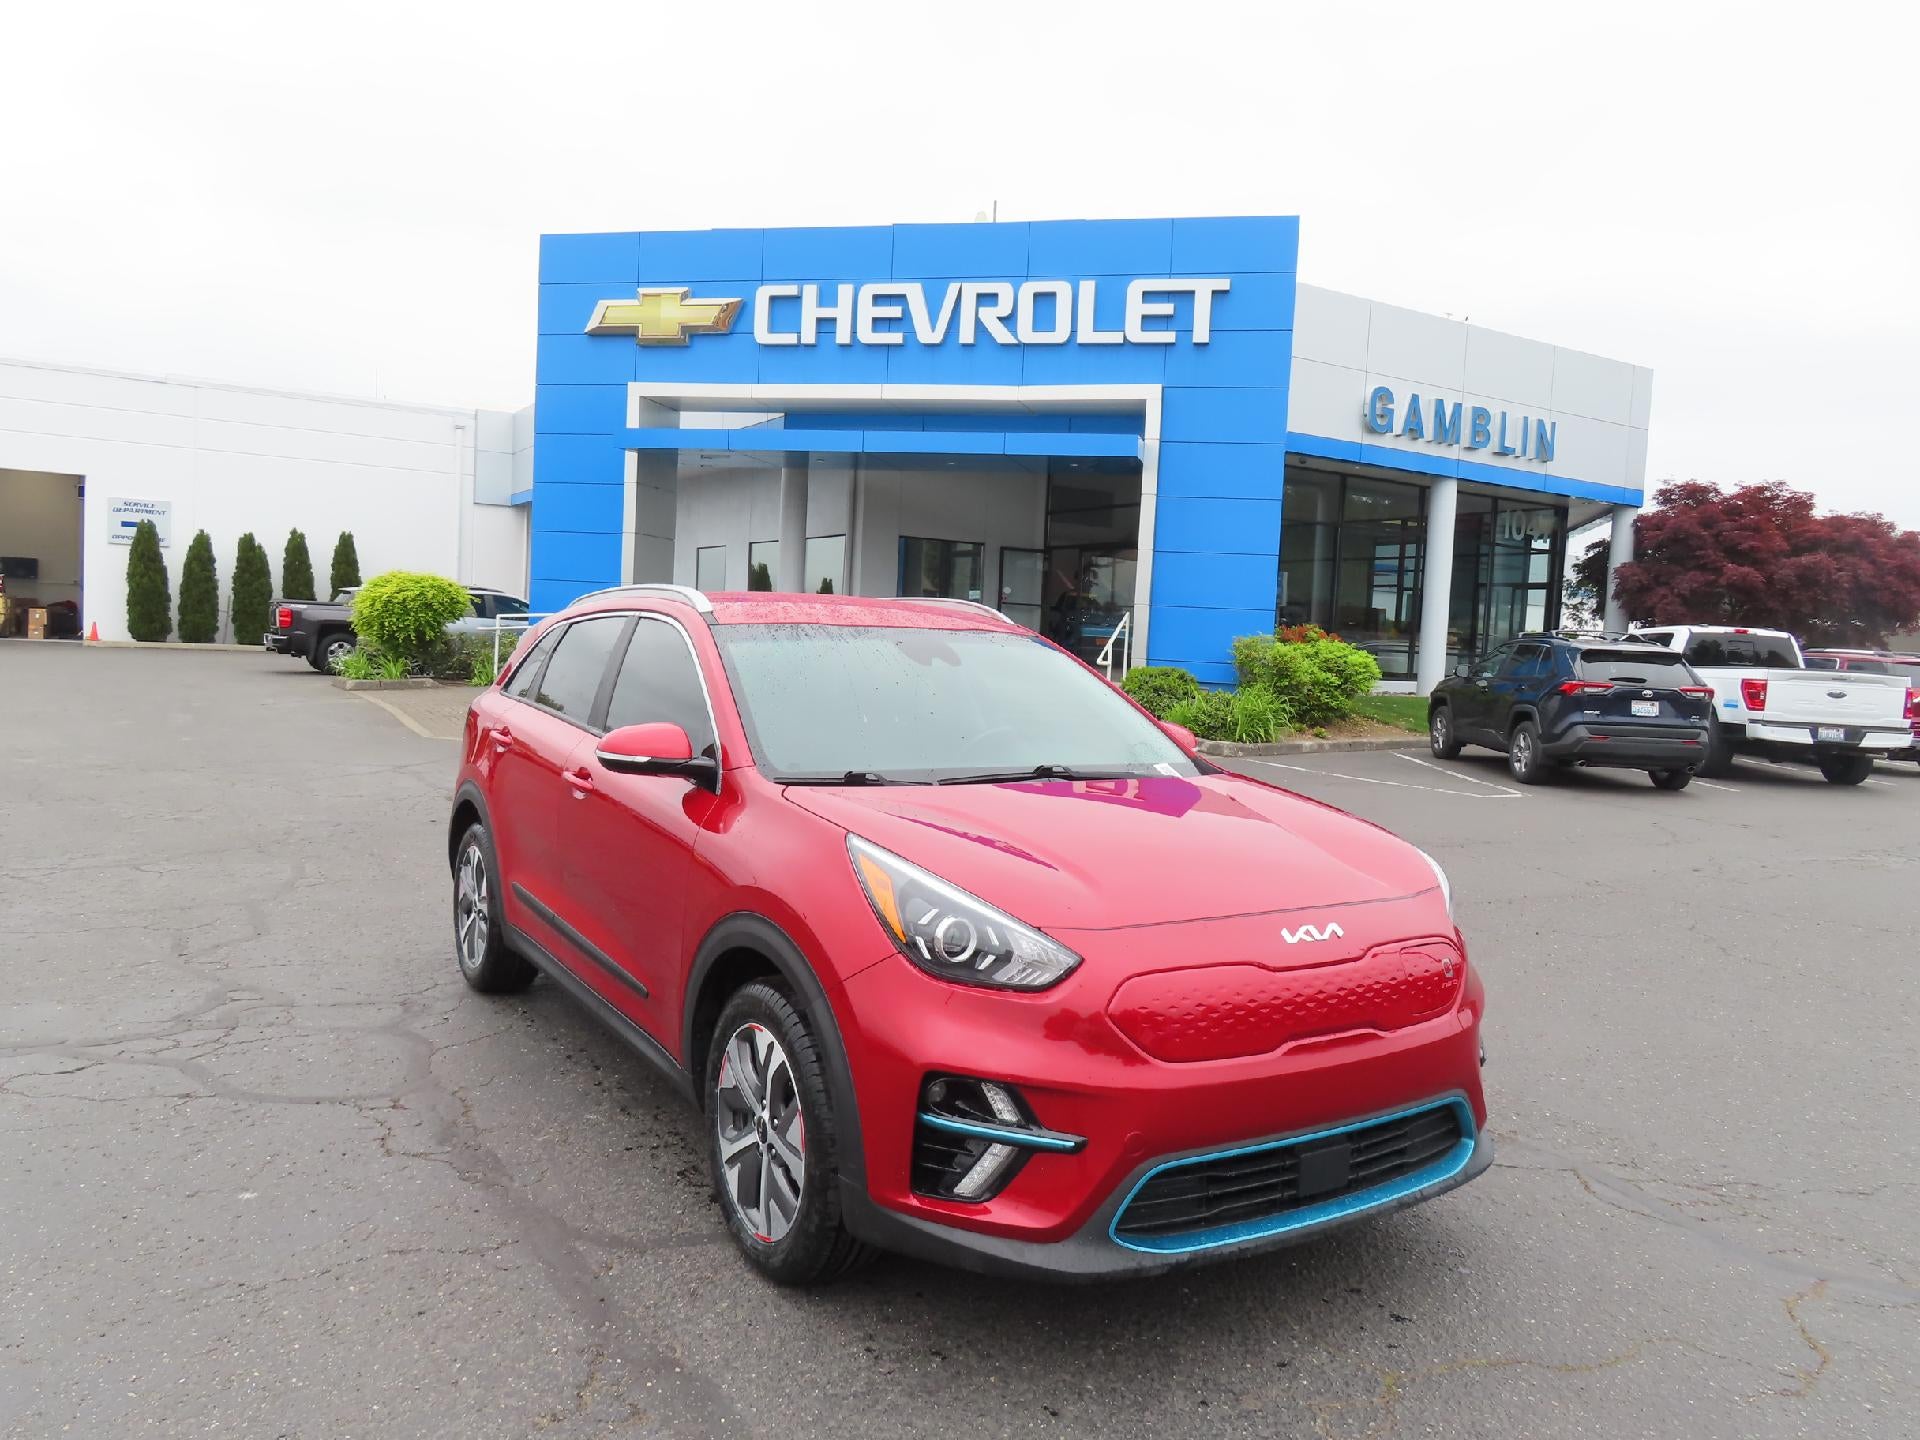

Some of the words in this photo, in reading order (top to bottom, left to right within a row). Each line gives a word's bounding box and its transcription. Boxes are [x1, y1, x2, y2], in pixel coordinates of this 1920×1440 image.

[753, 278, 1231, 345] CHEVROLET
[1364, 386, 1557, 463] GAMBLIN
[112, 507, 167, 516] DEPARTMENT
[123, 501, 156, 509] SERVICE
